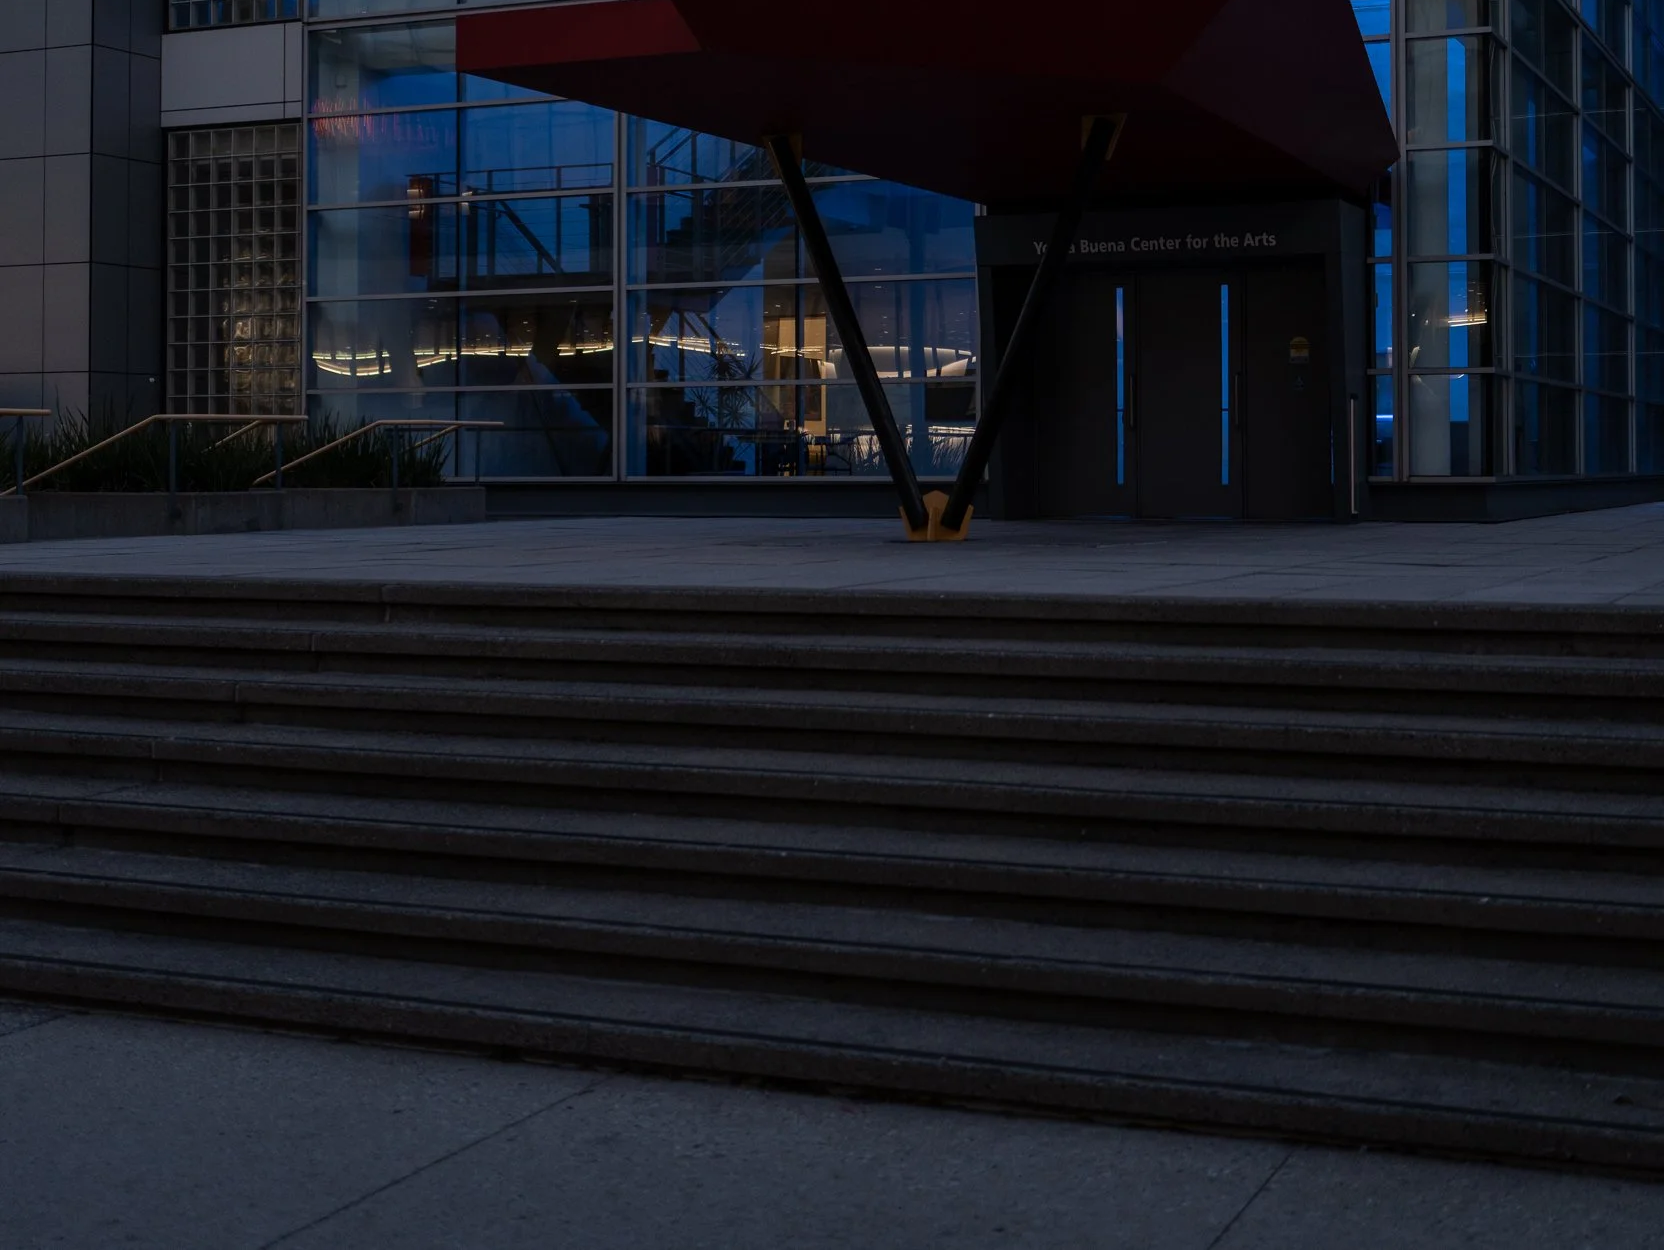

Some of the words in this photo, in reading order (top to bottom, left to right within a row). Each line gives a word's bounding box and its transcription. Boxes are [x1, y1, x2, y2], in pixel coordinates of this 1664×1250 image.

[1079, 238, 1126, 254] Buena
[1130, 235, 1182, 252] Center
[1185, 233, 1209, 250] for
[1213, 232, 1240, 249] the
[1244, 231, 1277, 248] Arts
